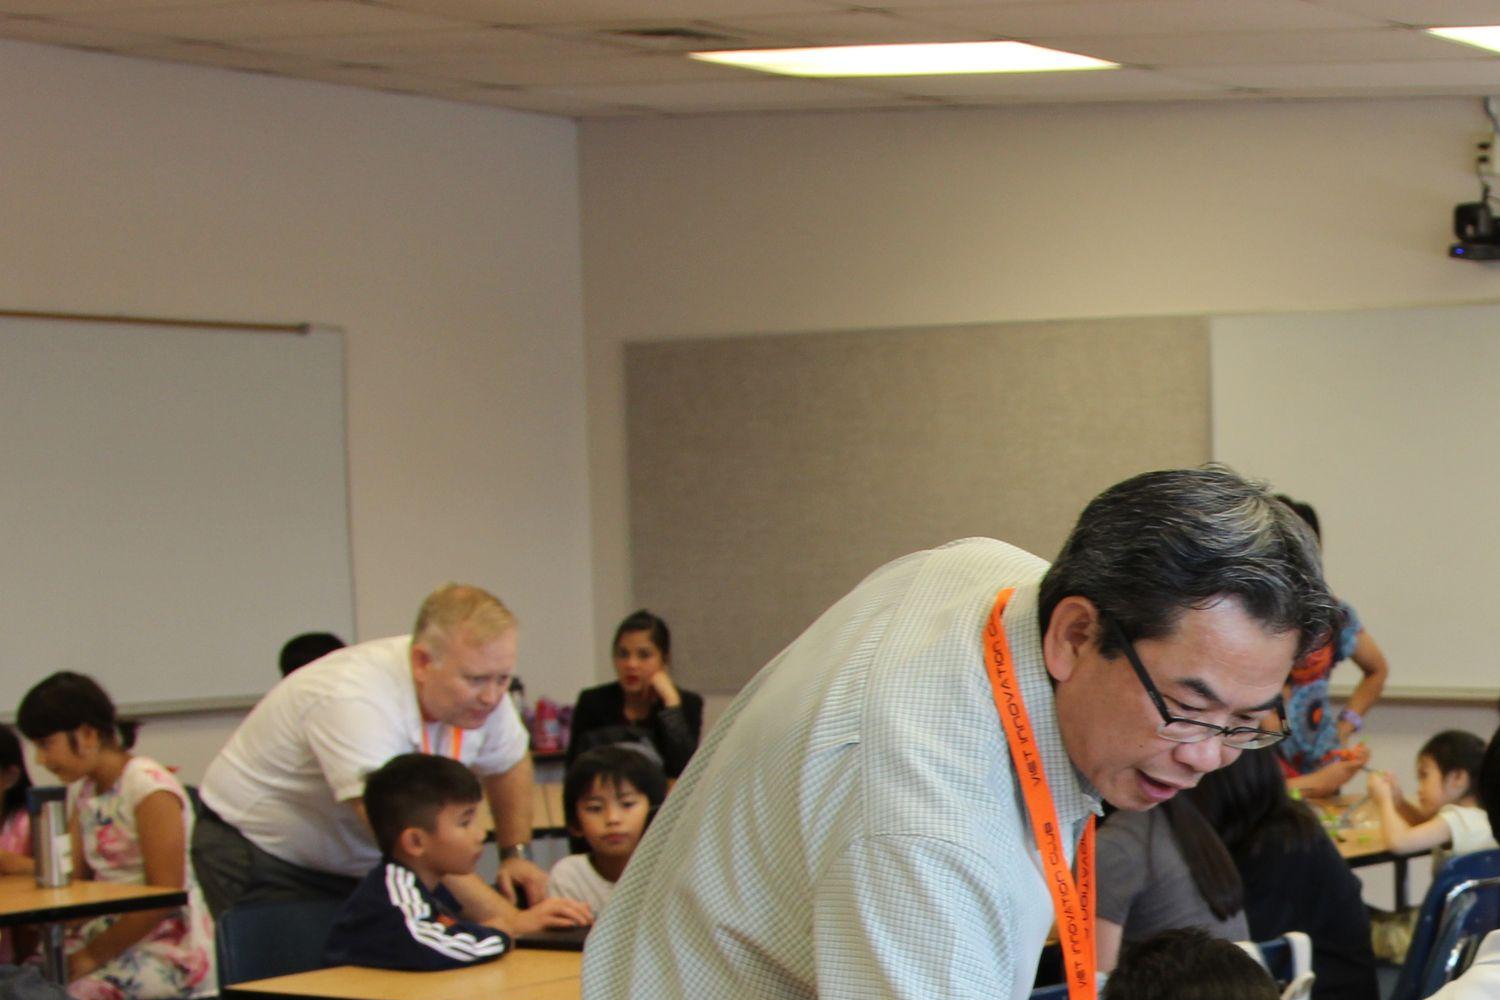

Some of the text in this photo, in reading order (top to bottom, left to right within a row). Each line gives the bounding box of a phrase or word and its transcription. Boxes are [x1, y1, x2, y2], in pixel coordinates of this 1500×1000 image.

[991, 641, 1028, 744] INNOVATION
[1023, 751, 1041, 787] VIET
[1043, 822, 1060, 867] CLUB
[1055, 869, 1082, 955] INNOVATION
[1074, 961, 1087, 988] VIET
